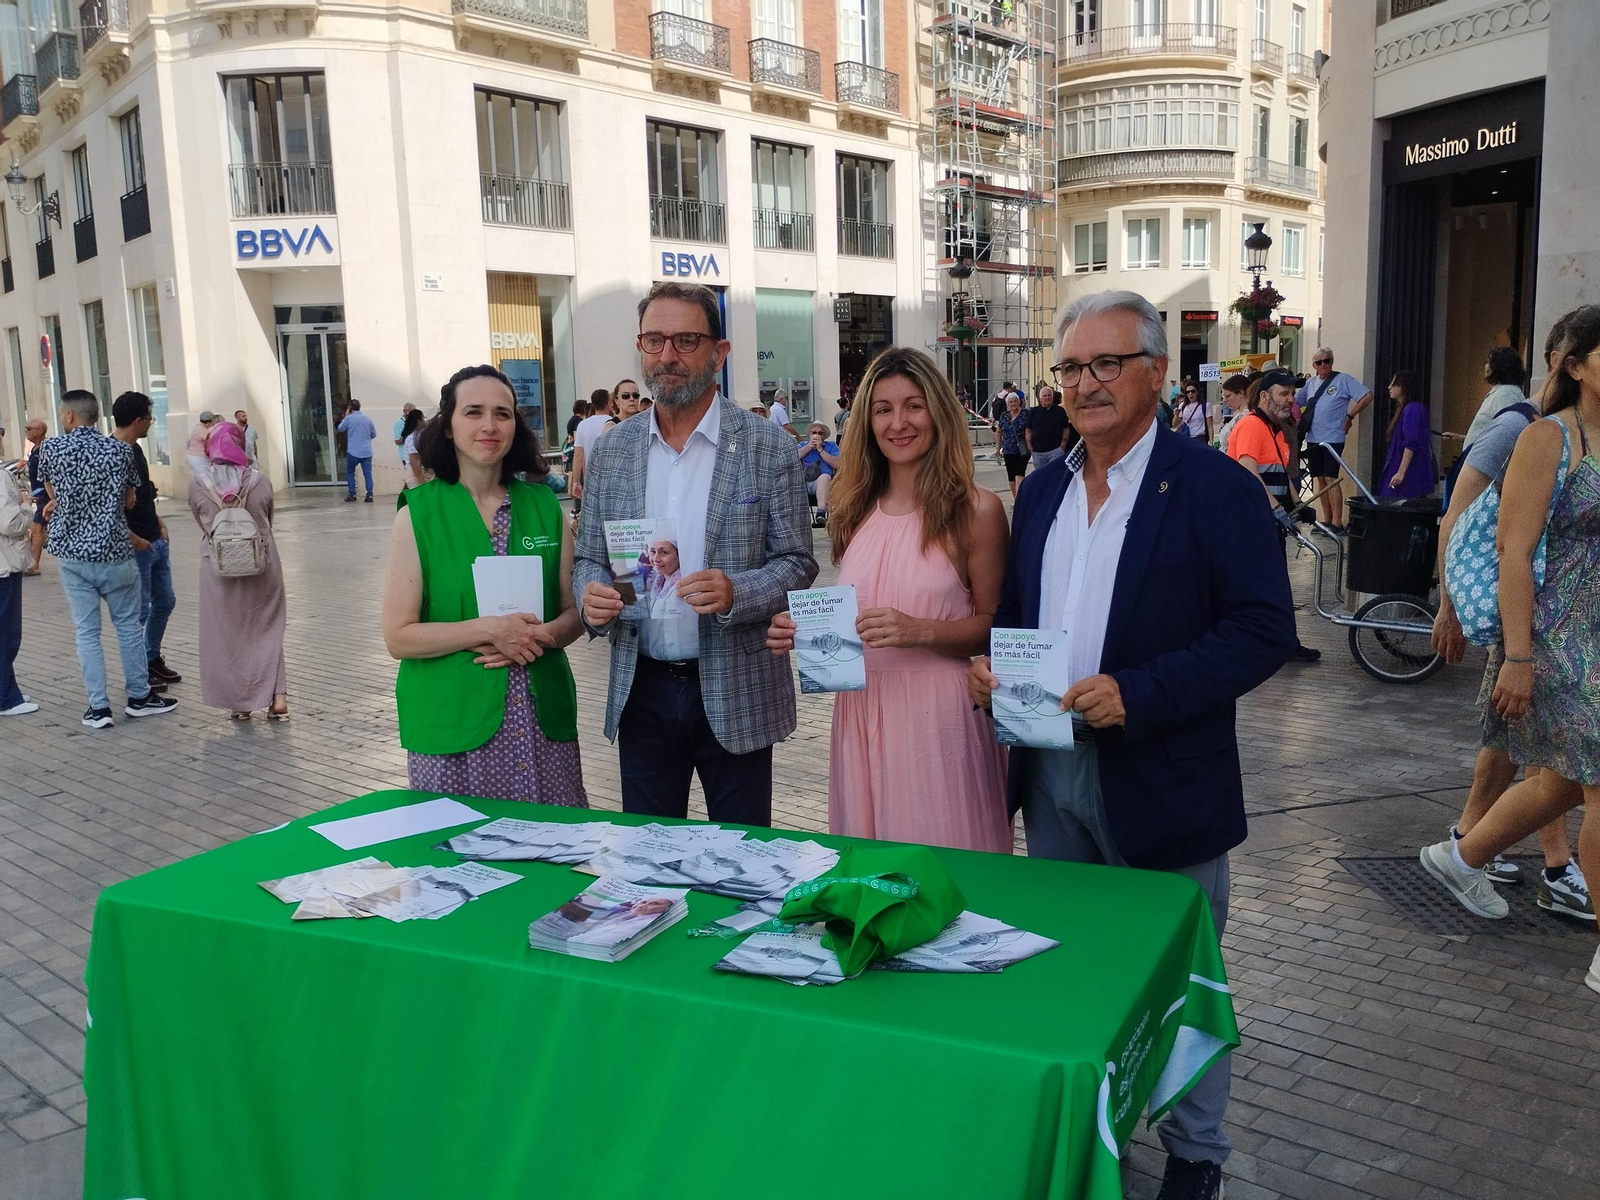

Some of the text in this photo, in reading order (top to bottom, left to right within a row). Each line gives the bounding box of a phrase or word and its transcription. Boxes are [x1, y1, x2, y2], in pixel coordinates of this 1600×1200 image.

[1405, 121, 1517, 166] Massimo Dutti
[236, 224, 334, 259] BBVA
[661, 252, 720, 278] BBVA
[491, 331, 540, 350] BBVA
[1200, 370, 1220, 378] 18513
[610, 530, 625, 538] dejar
[790, 593, 804, 601] Con
[791, 597, 844, 610] dejar de fumar
[801, 607, 817, 616] más
[818, 606, 835, 614] fácil
[994, 631, 1009, 640] Con
[994, 641, 1053, 651] dejar de fumar
[1004, 650, 1021, 659] más
[1022, 650, 1041, 659] fácil
